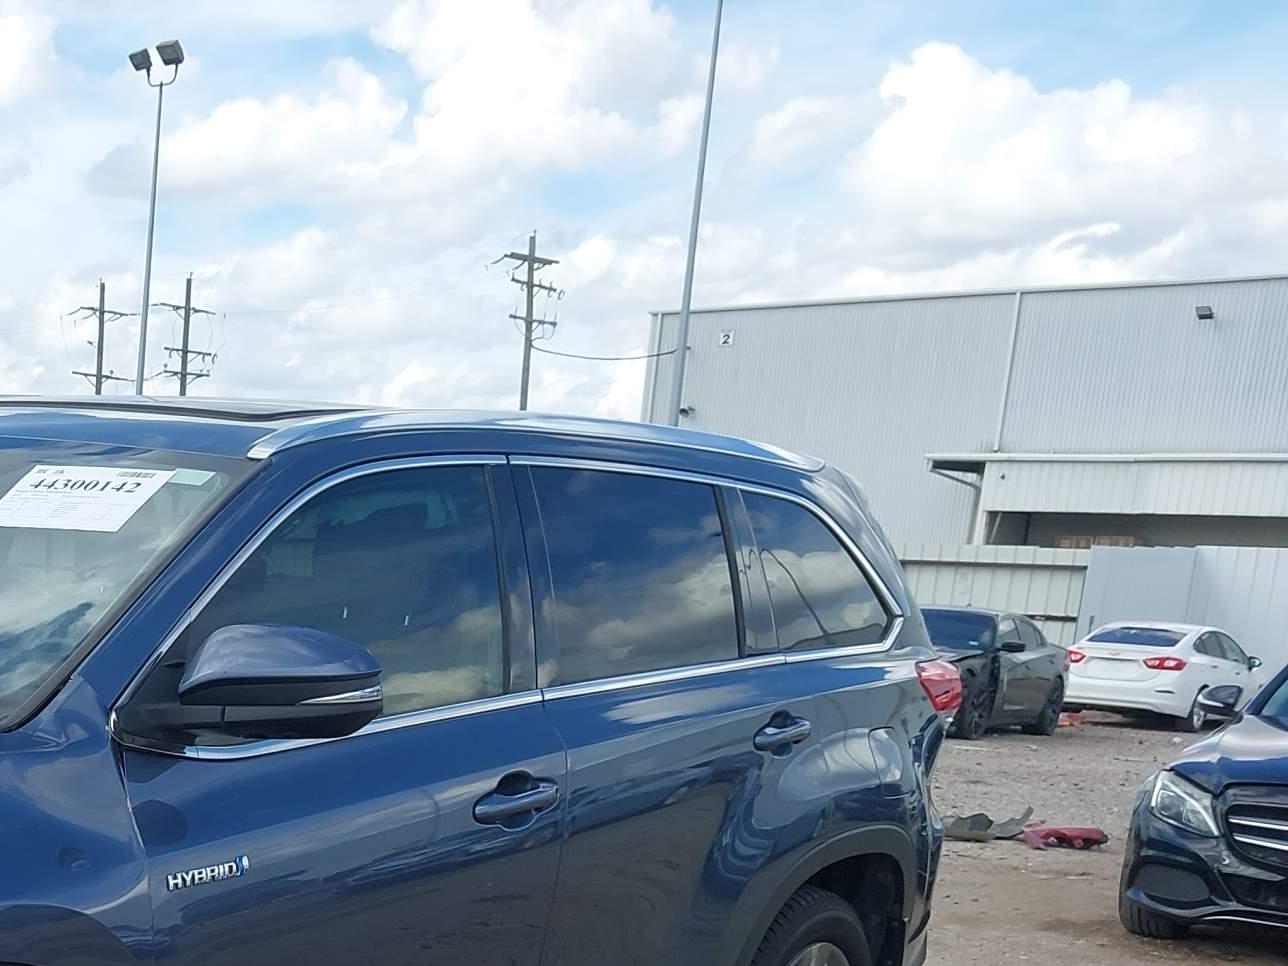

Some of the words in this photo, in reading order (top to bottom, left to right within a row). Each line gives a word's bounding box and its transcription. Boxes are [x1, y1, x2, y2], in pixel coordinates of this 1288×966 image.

[721, 333, 731, 345] 2
[29, 478, 143, 493] 44300142
[167, 861, 238, 891] HYBRID
